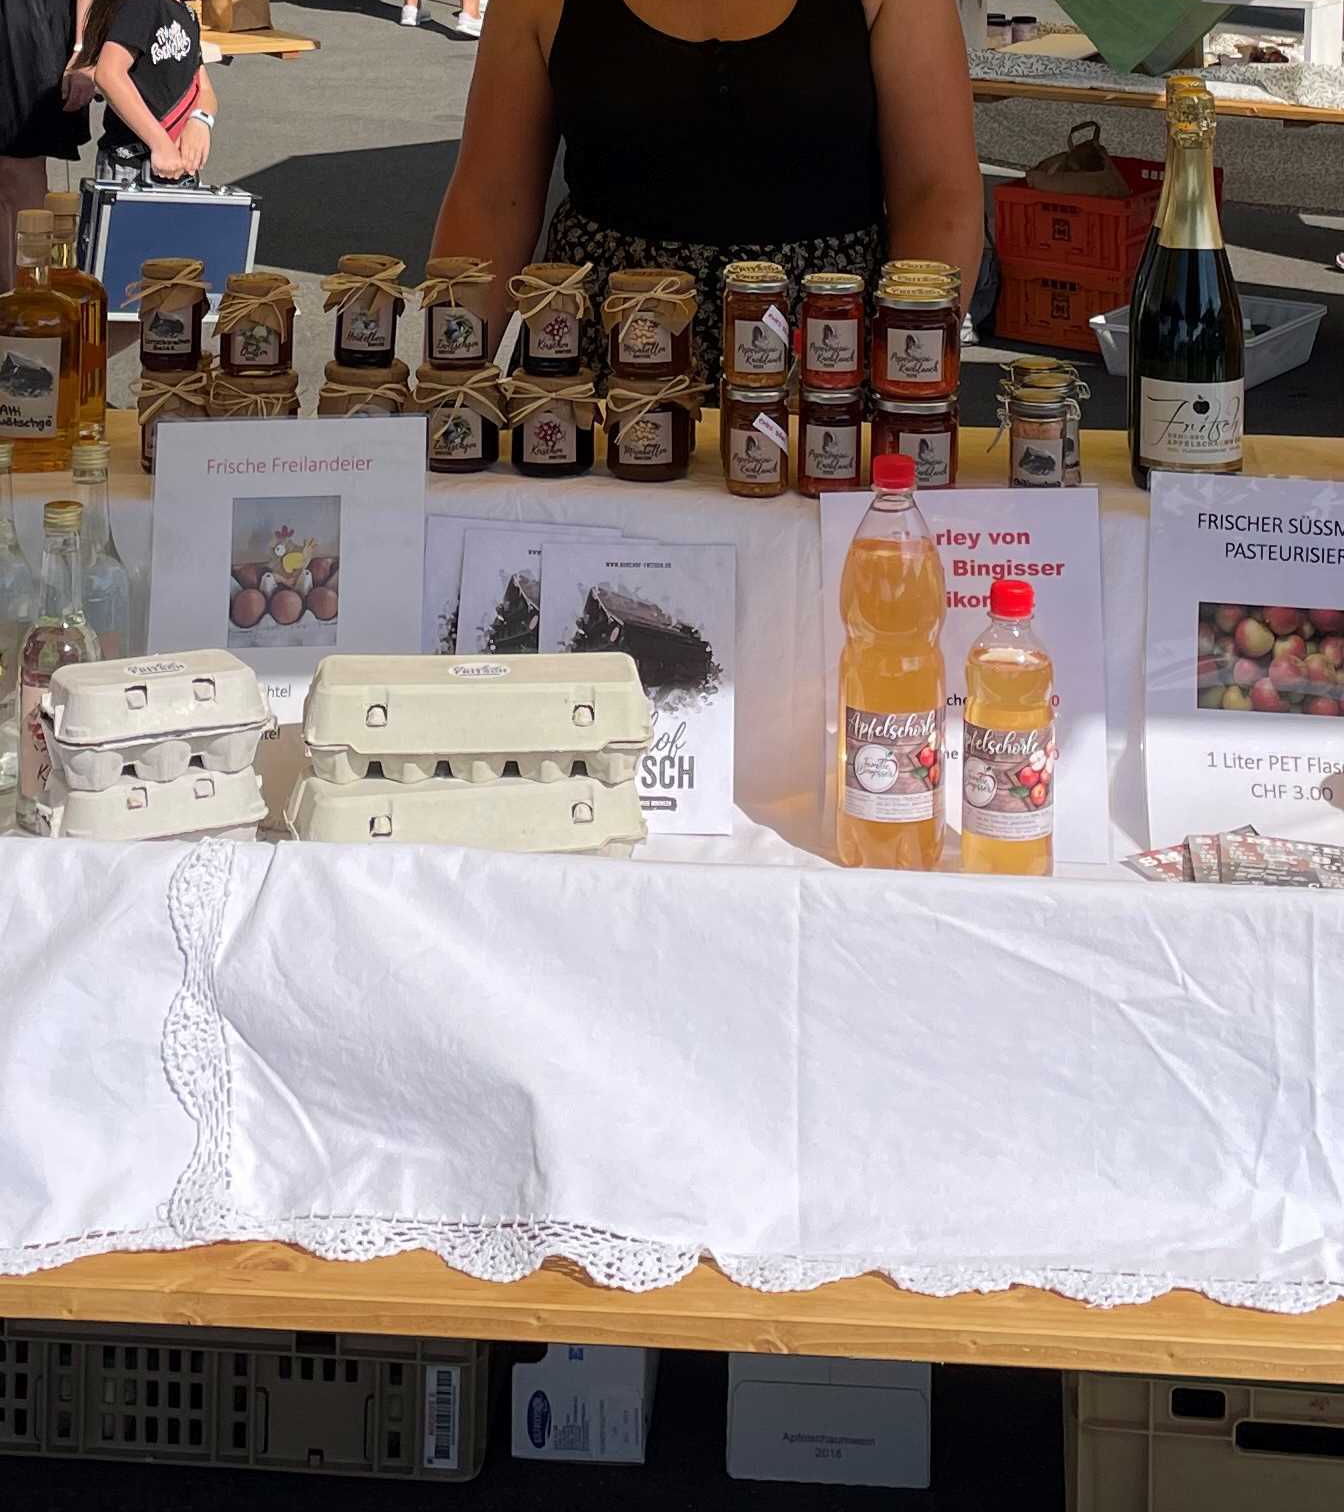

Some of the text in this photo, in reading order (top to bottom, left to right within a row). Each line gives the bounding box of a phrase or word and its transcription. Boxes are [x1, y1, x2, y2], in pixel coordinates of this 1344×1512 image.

[207, 456, 373, 474] Frische Freilandeier
[1198, 513, 1283, 535] FRISCHER
[987, 533, 1030, 545] von
[952, 559, 1065, 580] Bingisser
[849, 710, 936, 741] Apfelschorle
[1207, 752, 1216, 768] 1
[1223, 753, 1263, 772] Liter
[1269, 755, 1301, 773] PET
[1251, 783, 1333, 802] CHF 3.00
